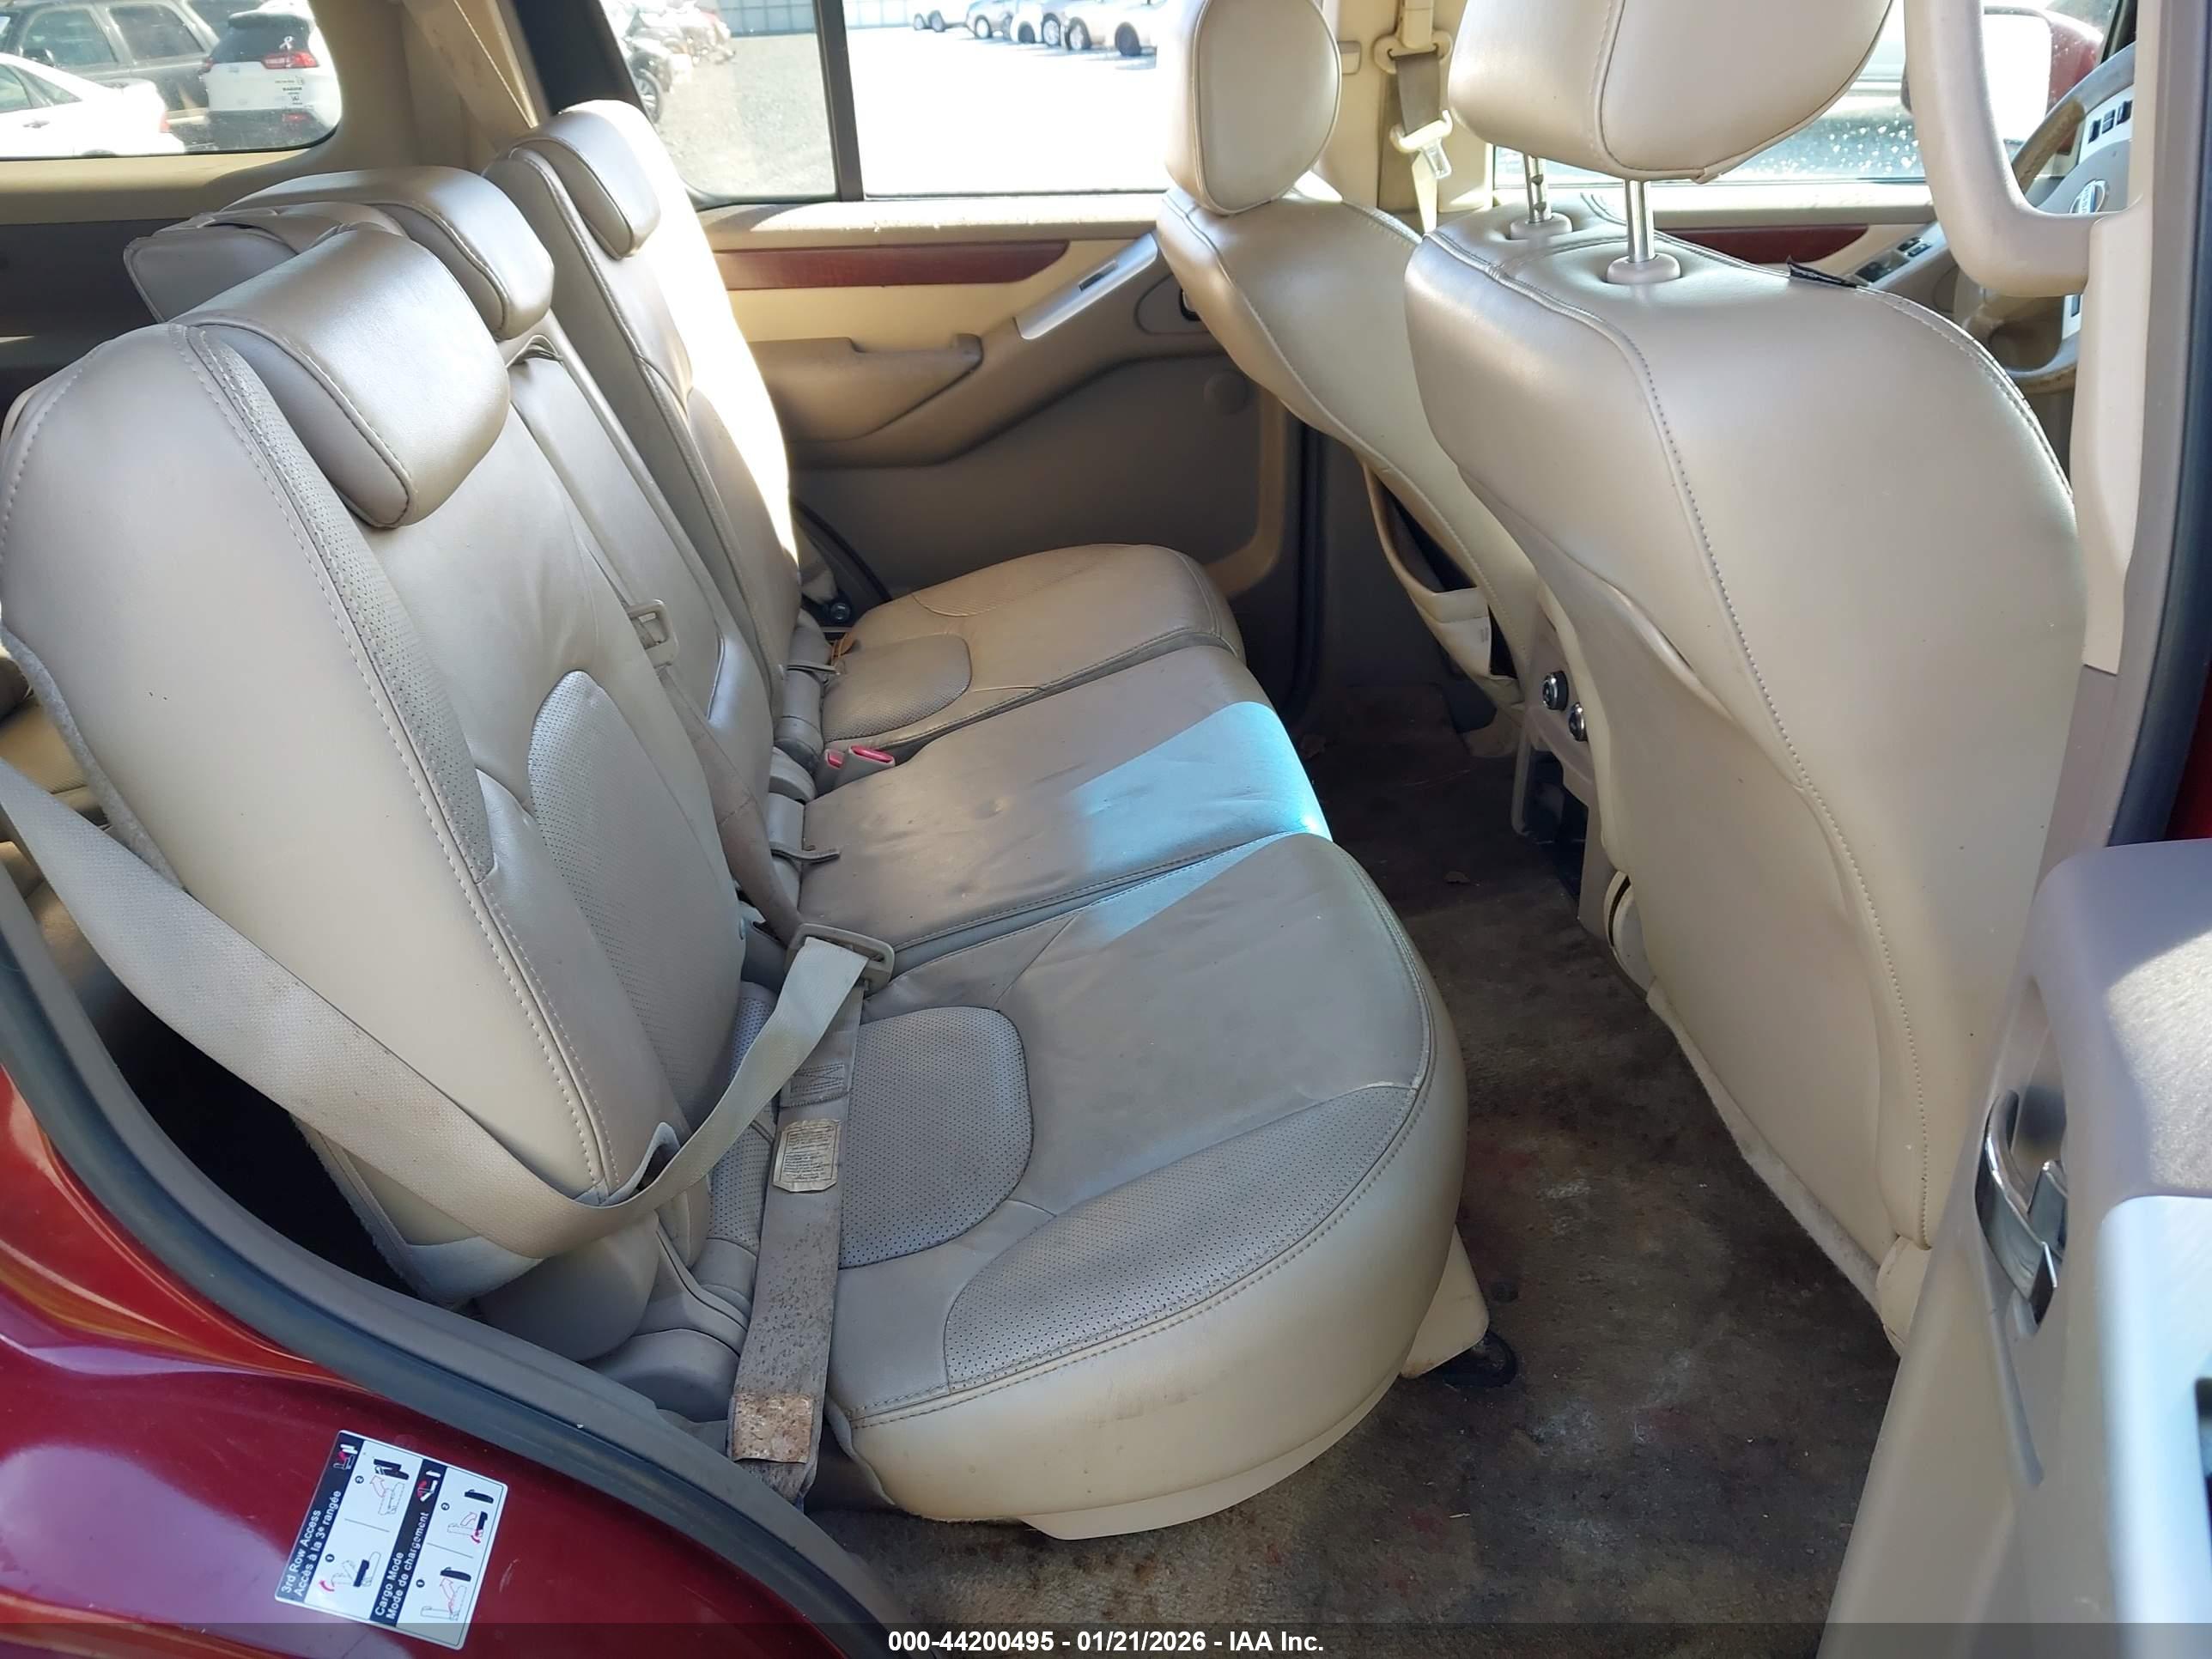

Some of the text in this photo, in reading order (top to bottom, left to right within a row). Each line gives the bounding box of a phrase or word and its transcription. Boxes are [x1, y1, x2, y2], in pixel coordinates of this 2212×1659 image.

[282, 1510, 321, 1593] 3rd Row Access
[294, 1563, 314, 1596] Accès
[310, 1540, 323, 1552] la
[322, 1490, 342, 1526] rangée
[374, 1552, 404, 1616] Cargo Mode
[386, 1512, 429, 1620] Mode de chargement
